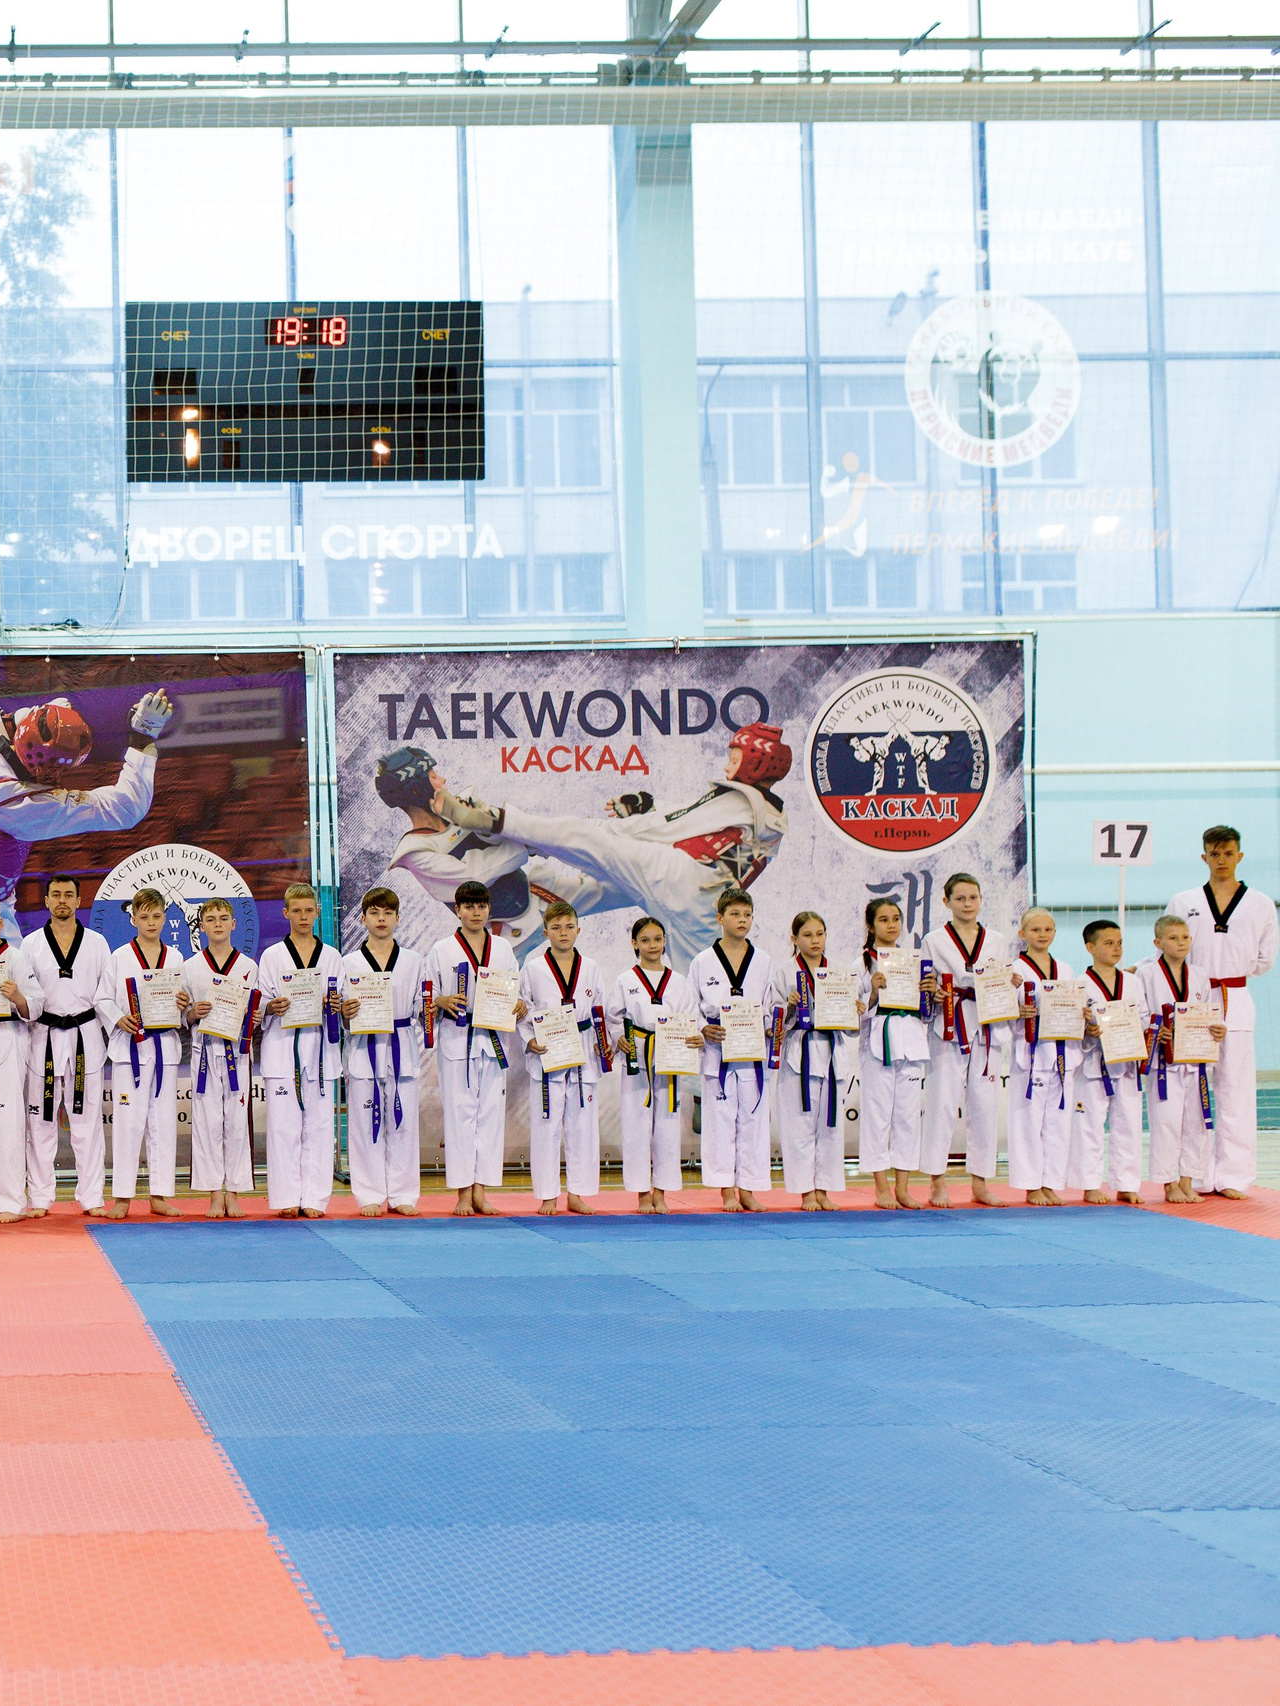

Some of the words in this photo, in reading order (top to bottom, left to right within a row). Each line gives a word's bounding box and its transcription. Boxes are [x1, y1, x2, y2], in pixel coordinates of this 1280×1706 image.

[1063, 241, 1134, 263] КЛУБ
[161, 331, 189, 342] СЧЕТ
[276, 317, 347, 346] 19:18
[422, 329, 450, 340] СЧЕТ
[1020, 491, 1036, 510] К
[125, 526, 305, 568] ДВОРЕЦ
[321, 524, 504, 559] СПОРТА
[378, 686, 770, 741] TAEKWONDO
[824, 682, 884, 736] ПЛАСТИКИ
[891, 680, 900, 689] И
[908, 681, 961, 713] БОЕВЫХ
[855, 700, 944, 724] TAEKWONDO
[501, 744, 650, 775] КАСКАД
[841, 797, 960, 822] КАСКАД
[874, 828, 931, 840] г.Пермь
[1100, 824, 1149, 859] 17
[130, 867, 217, 891] TAEKWONDO
[101, 850, 159, 901] ПЛАСТИКИ
[166, 849, 174, 858] И
[181, 849, 233, 881] БОЕВЫХ
[232, 882, 255, 955] ИСКУССТВ
